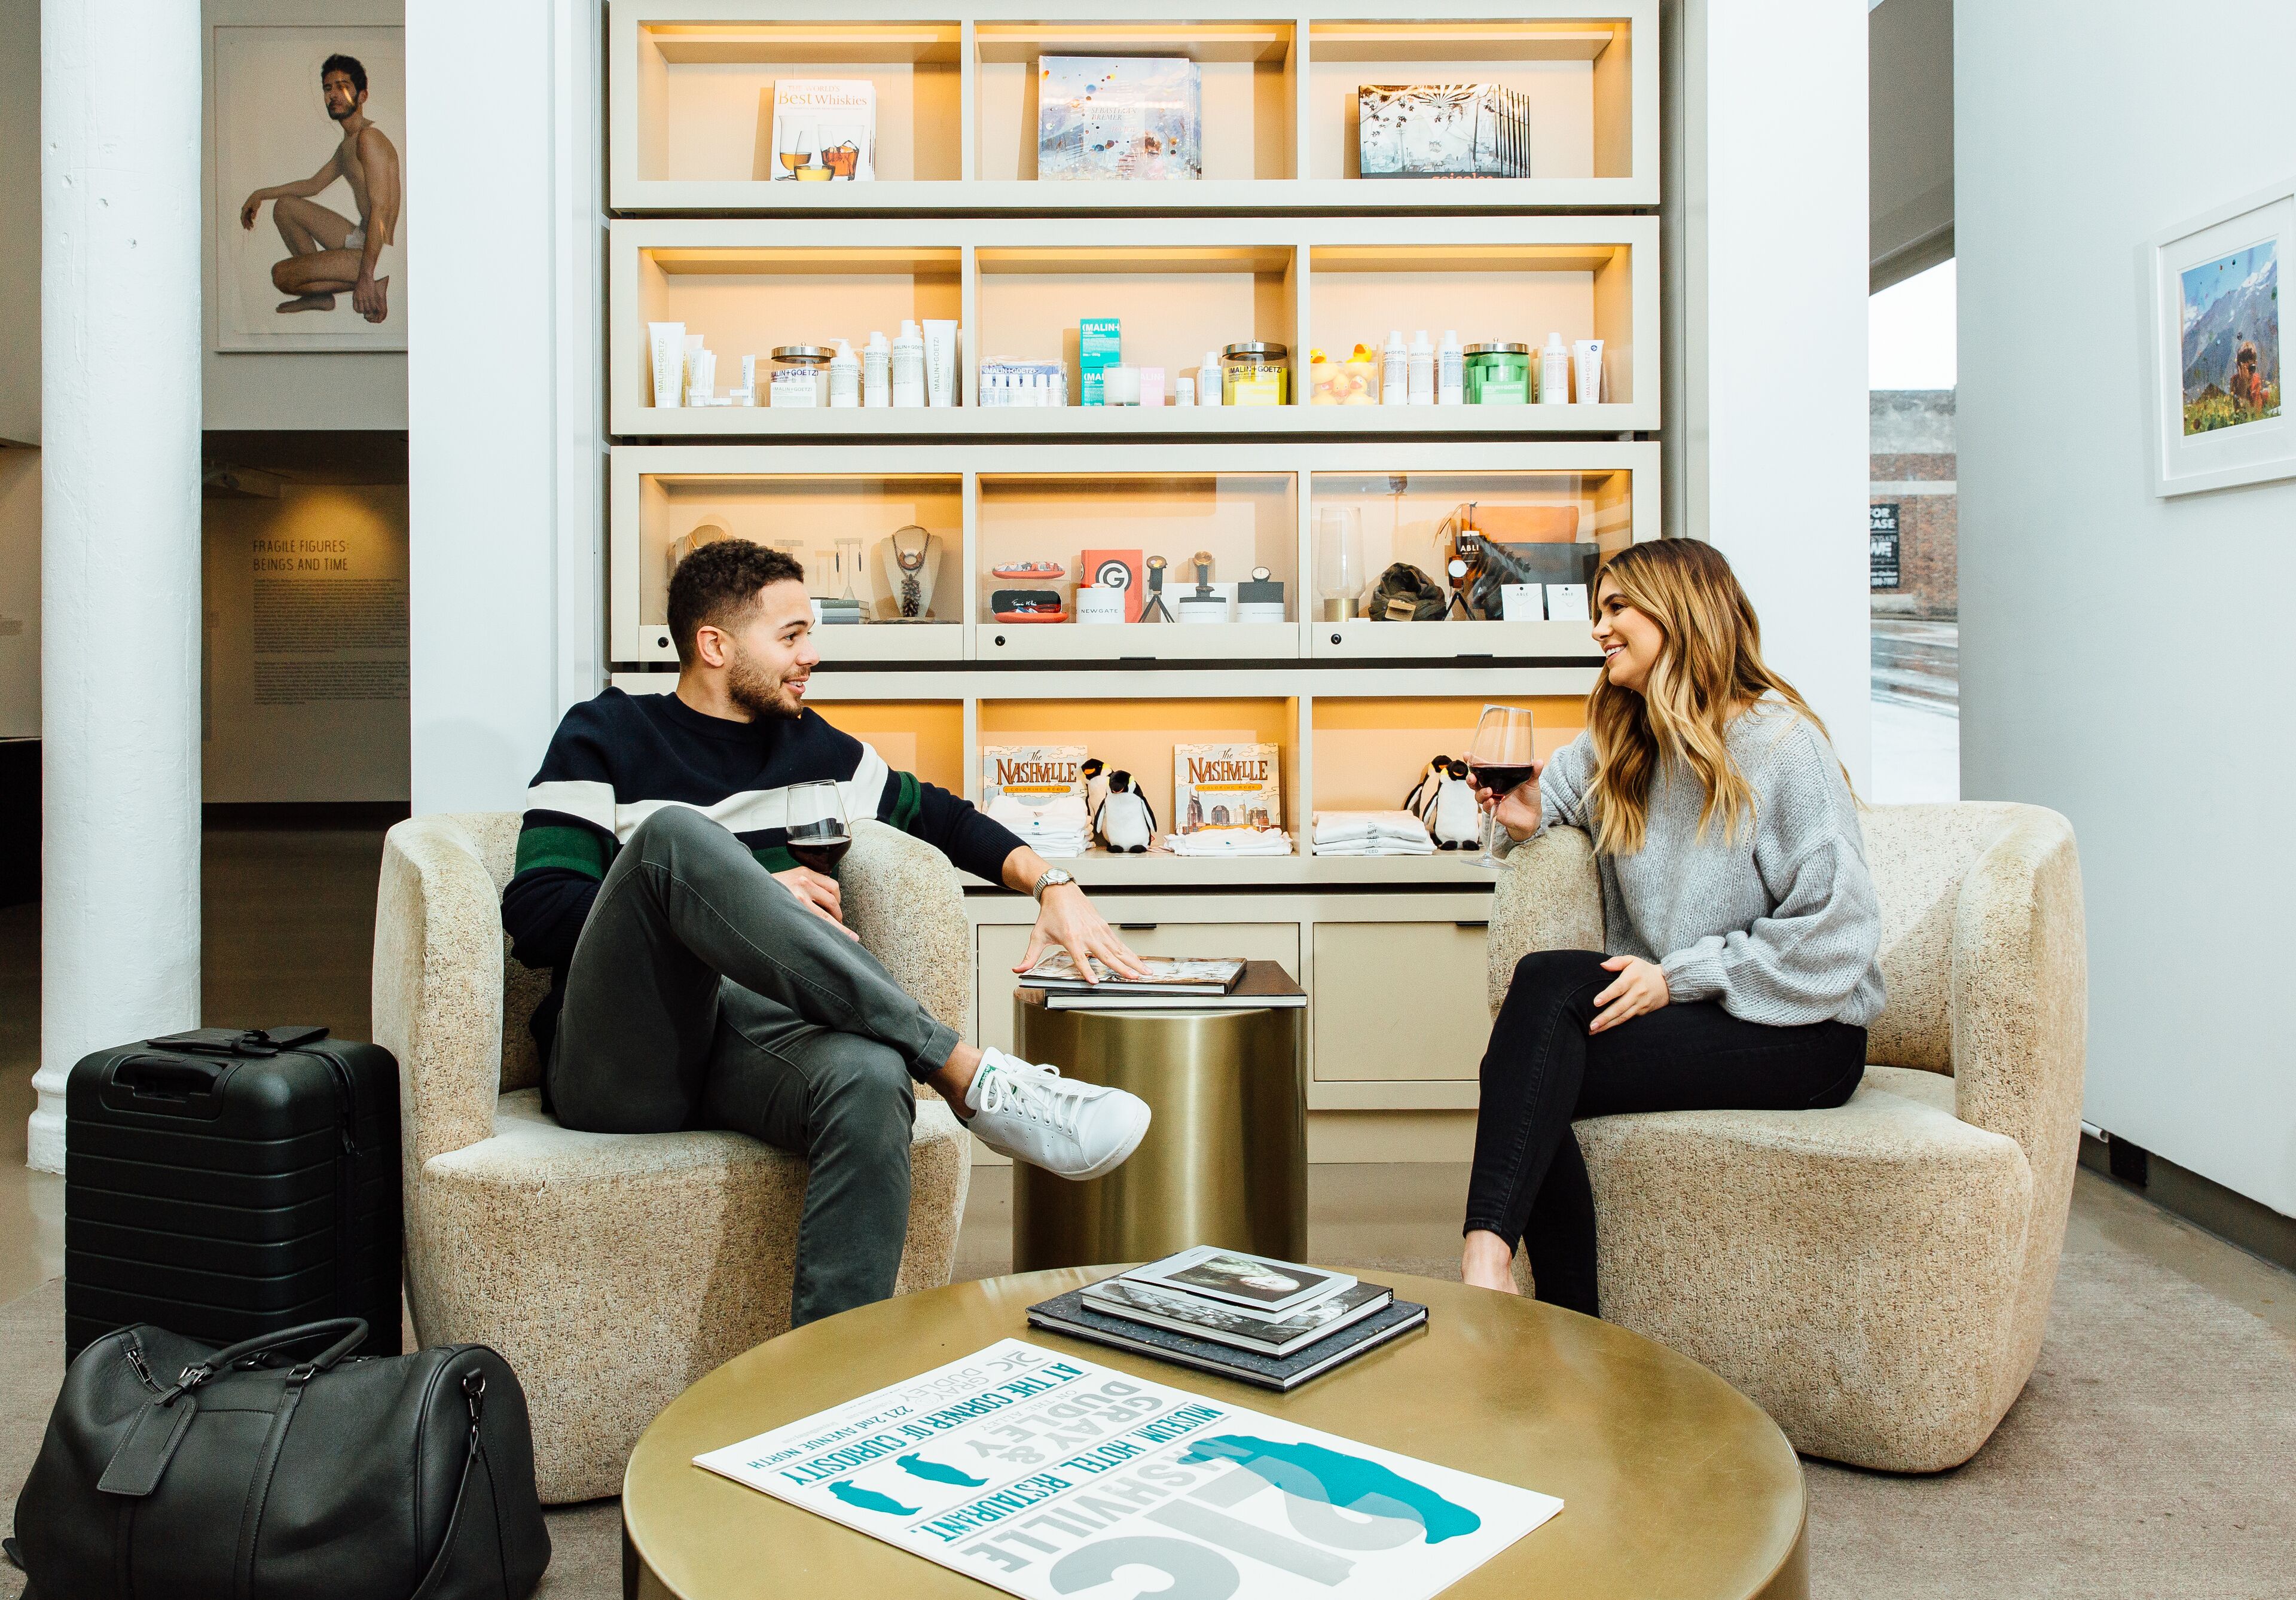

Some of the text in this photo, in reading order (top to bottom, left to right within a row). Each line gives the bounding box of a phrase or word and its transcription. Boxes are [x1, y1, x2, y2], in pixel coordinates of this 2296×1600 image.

[779, 91, 867, 106] Best Whiskies
[253, 540, 295, 552] FRAGILE
[253, 558, 348, 570] BEINGS AND TIME
[1027, 749, 1042, 761] The
[1218, 747, 1234, 760] The
[996, 758, 1077, 785] NASHVILLE
[1187, 757, 1268, 784] NASHVILLE
[899, 1367, 984, 1401] DUDLEY
[1041, 1362, 1084, 1382] AT
[937, 1376, 990, 1401] GRAY
[997, 1376, 1057, 1398] THE
[917, 1393, 1013, 1429] CORNER
[964, 1380, 1142, 1458] DUDLEY
[979, 1390, 1077, 1431] ON THE ALLEY
[746, 1405, 914, 1469] 221 2nd AVENUE NORTH
[896, 1424, 934, 1441] OF
[997, 1392, 1163, 1464] GRAY &
[779, 1434, 907, 1486] CURIOSITY
[960, 1437, 1253, 1573] NASHVILLE
